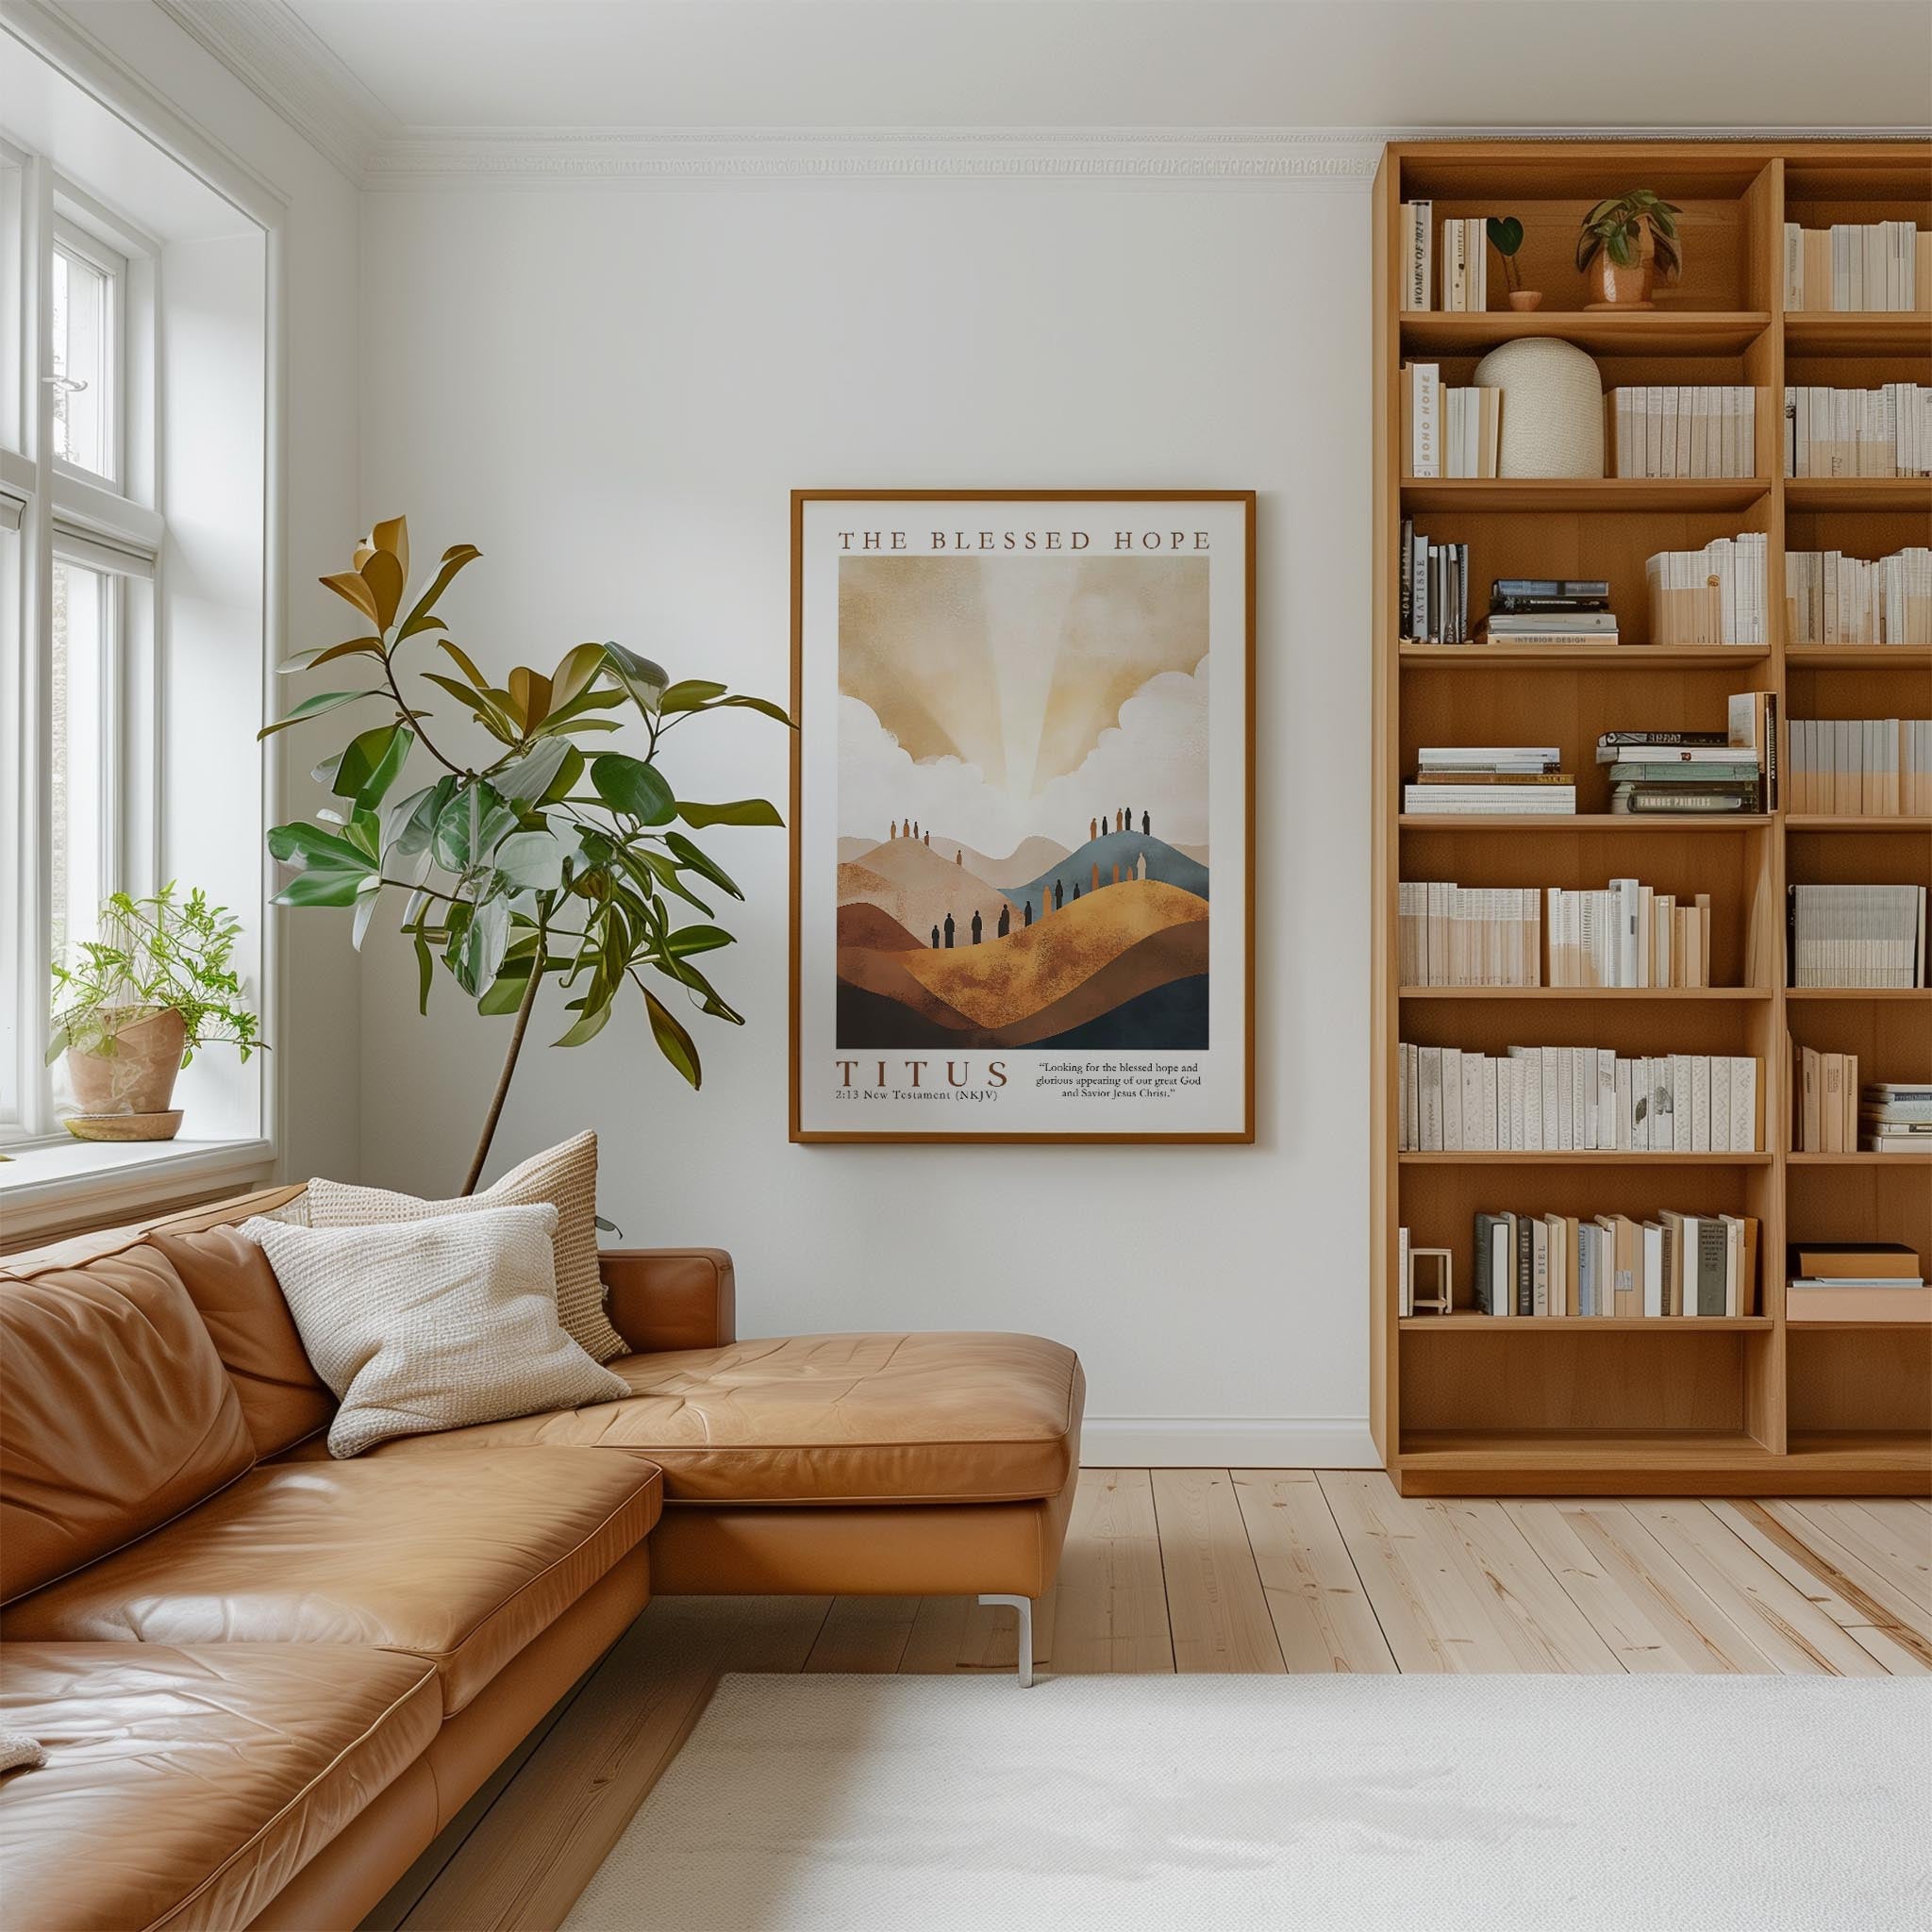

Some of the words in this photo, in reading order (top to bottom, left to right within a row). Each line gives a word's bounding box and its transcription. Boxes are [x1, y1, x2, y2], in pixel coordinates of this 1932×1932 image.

[1415, 220, 1424, 243] 2024
[1415, 243, 1424, 260] OF
[1413, 262, 1424, 306] WOMEN
[1421, 375, 1430, 415] HOME
[1421, 421, 1430, 461] BOHO
[838, 531, 908, 550] THE
[931, 531, 1090, 550] BLESSED
[1114, 531, 1210, 550] HOPE
[1416, 558, 1425, 625] MATISSE
[1640, 797, 1671, 807] FAMOUS
[836, 1061, 1008, 1087] TITUS
[1039, 1062, 1083, 1074] “Looking
[1086, 1062, 1100, 1072] for
[1102, 1062, 1117, 1072] the
[1119, 1062, 1153, 1073] blessed
[1156, 1062, 1179, 1074] hope
[1181, 1062, 1198, 1073] and
[1036, 1075, 1074, 1087] glorious
[1075, 1076, 1122, 1088] appearing
[1123, 1075, 1135, 1085] of
[1154, 1076, 1178, 1088] great
[1180, 1075, 1201, 1086] God
[836, 1090, 859, 1100] 2:13
[863, 1090, 889, 1100] New
[892, 1090, 951, 1100] Testament
[955, 1090, 998, 1103] (NKJV)
[1061, 1089, 1079, 1098] and
[1081, 1088, 1111, 1098] Savior
[1111, 1089, 1137, 1100] Jesus
